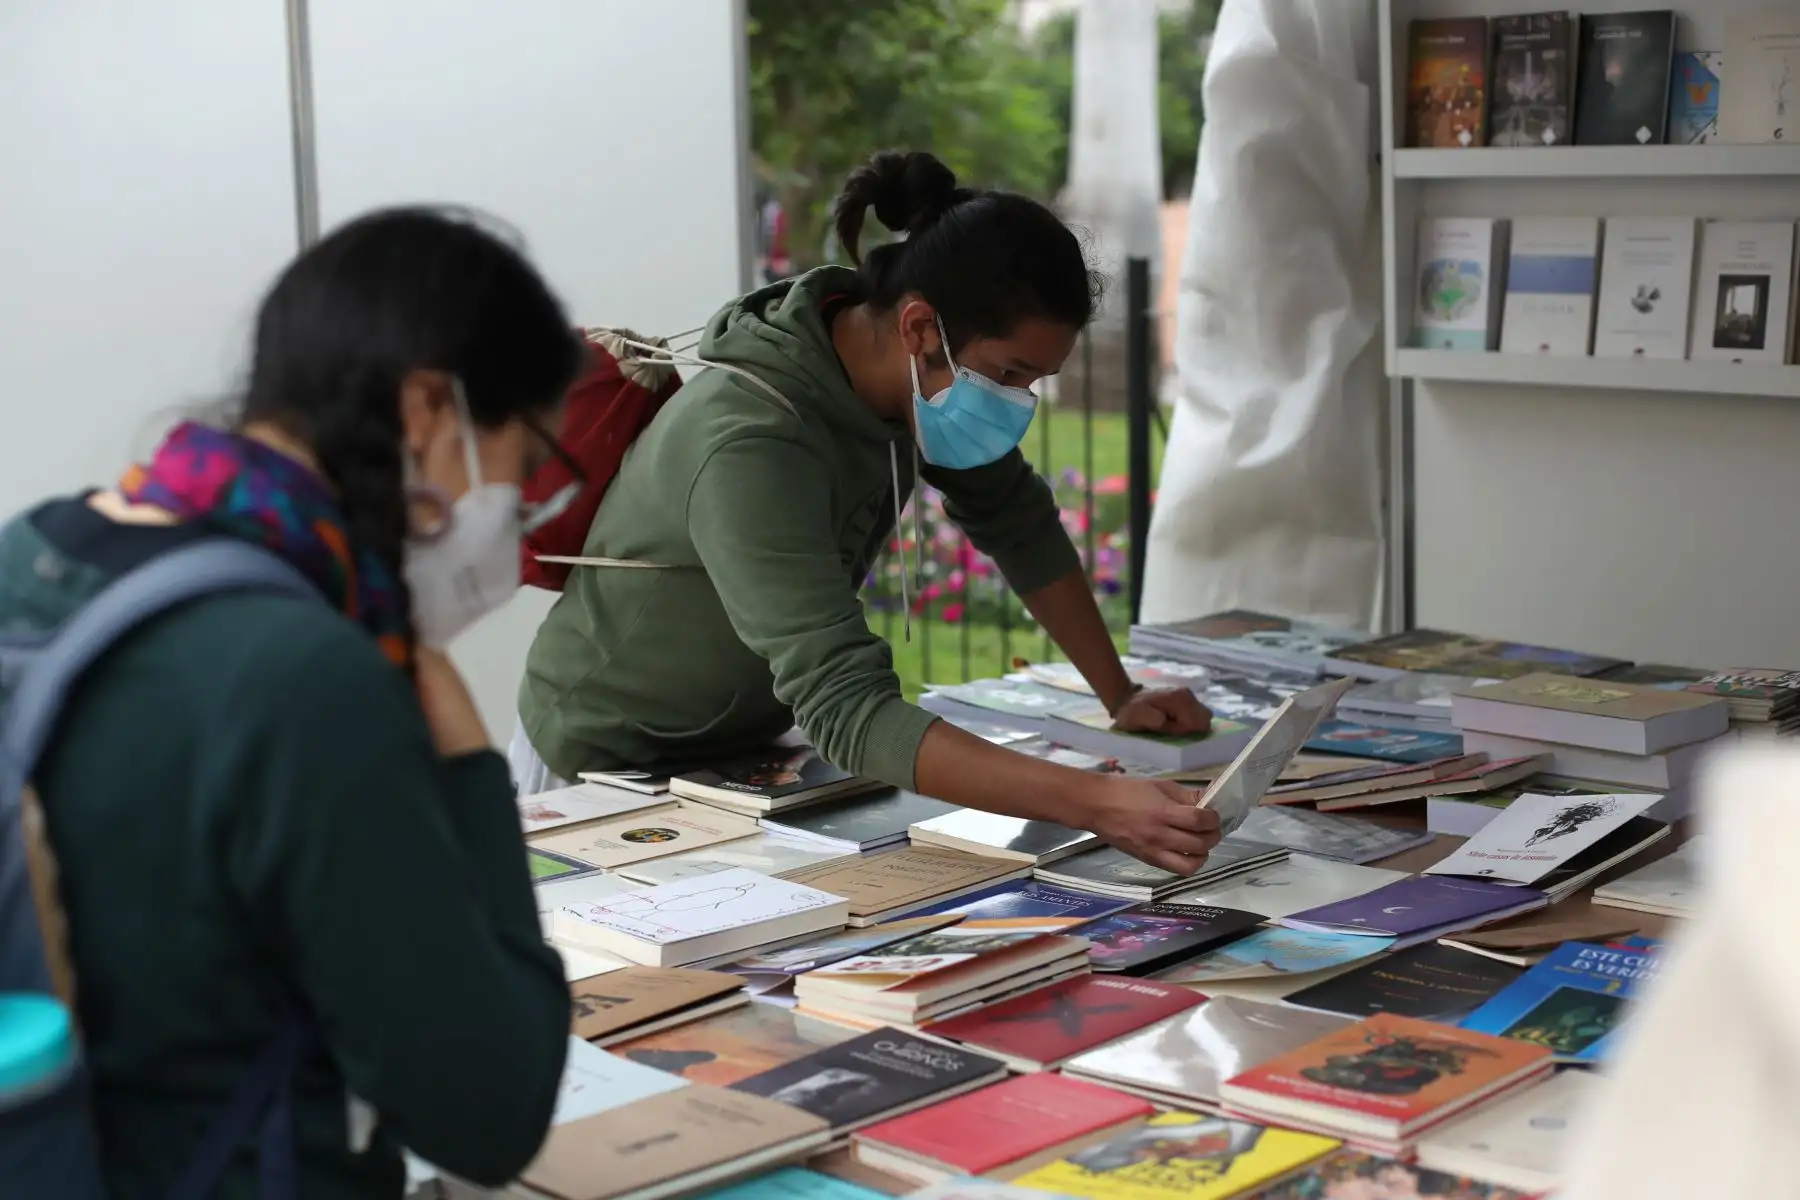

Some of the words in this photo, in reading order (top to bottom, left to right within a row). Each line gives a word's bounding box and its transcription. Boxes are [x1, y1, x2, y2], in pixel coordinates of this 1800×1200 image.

[1016, 890, 1039, 898] LOS
[1041, 895, 1088, 907] AMANTES
[1579, 948, 1623, 962] ESTE
[1571, 958, 1595, 971] ES
